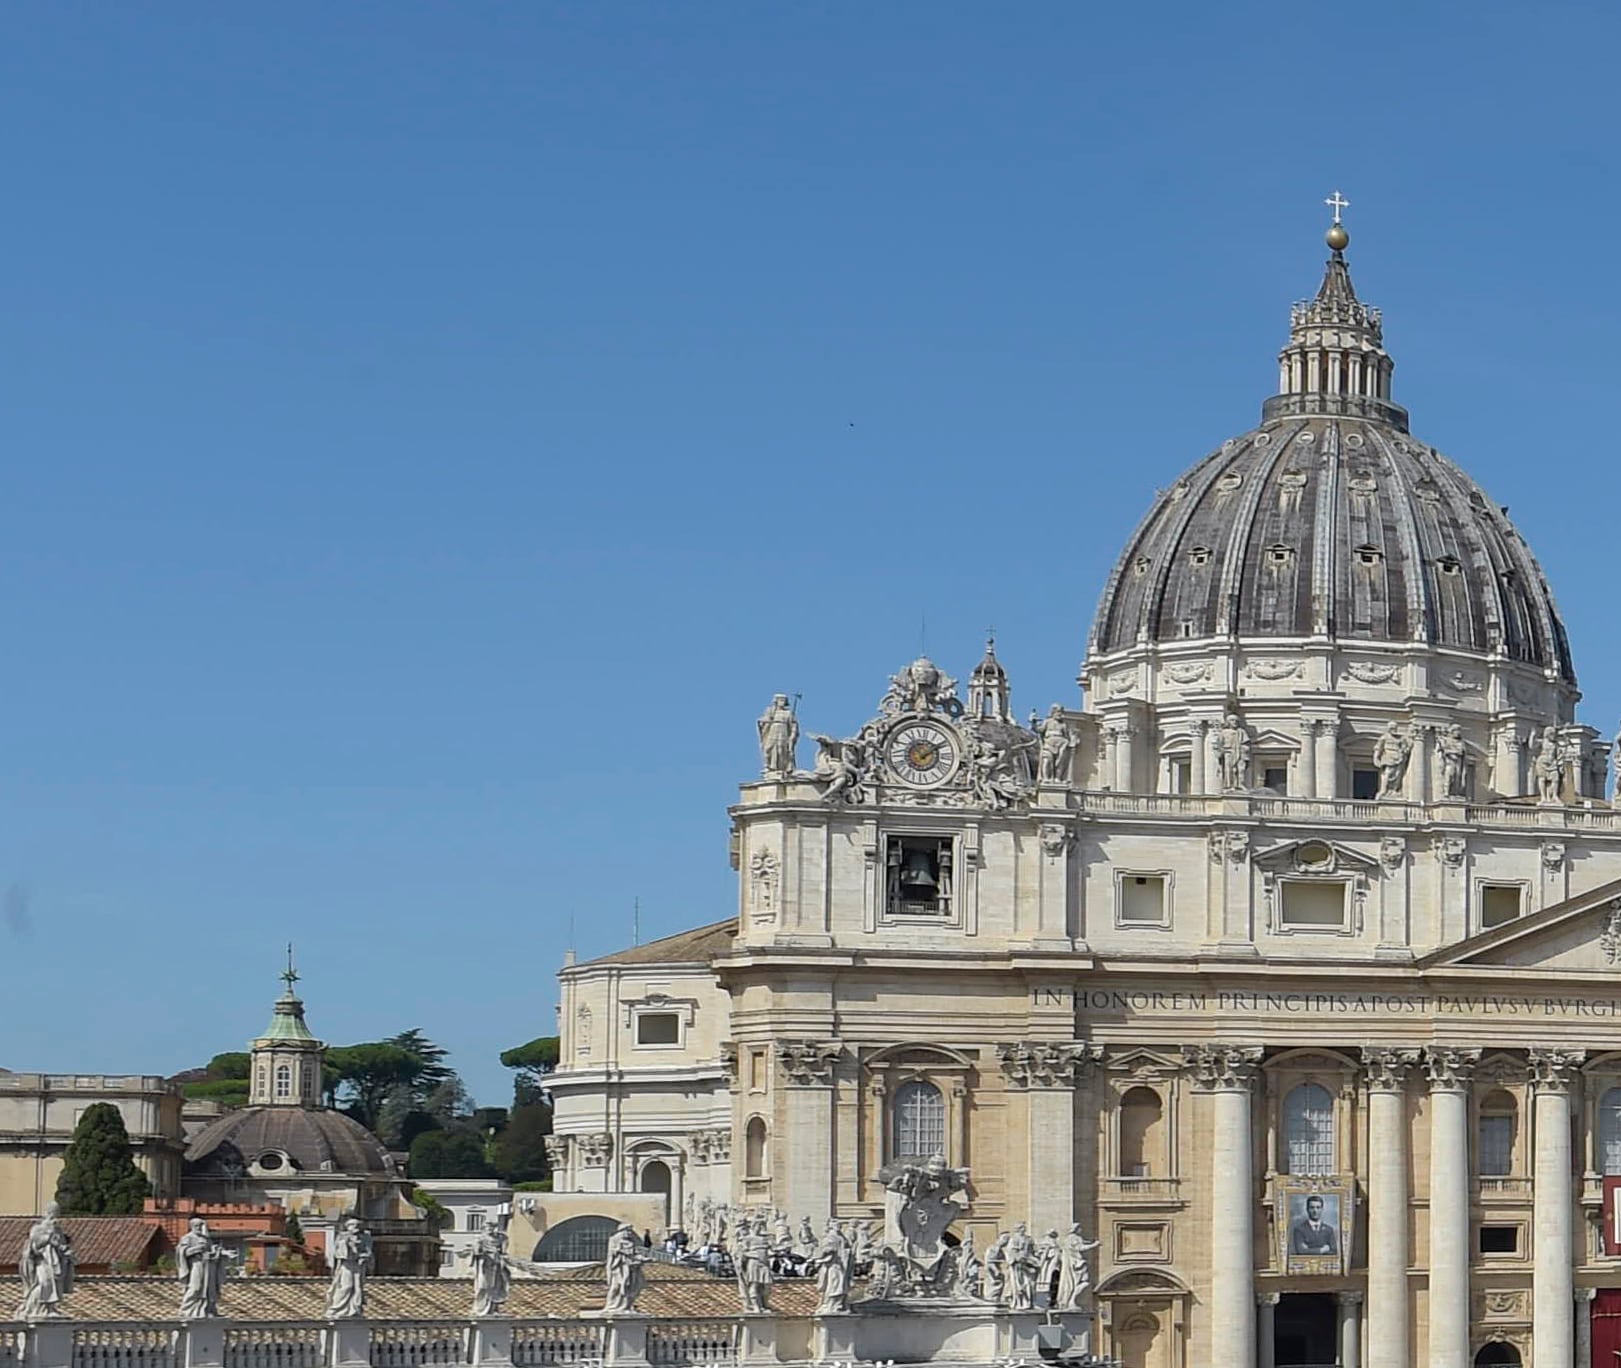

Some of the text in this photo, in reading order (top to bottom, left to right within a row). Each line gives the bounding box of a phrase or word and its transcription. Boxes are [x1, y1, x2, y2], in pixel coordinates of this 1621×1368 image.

[1033, 989, 1063, 1006] IN
[1074, 990, 1207, 1010] HONOREM
[1218, 993, 1347, 1012] PRINCIPIS
[1352, 995, 1430, 1013] APOST
[1438, 996, 1516, 1014] PAVLVS
[1525, 998, 1537, 1014] V
